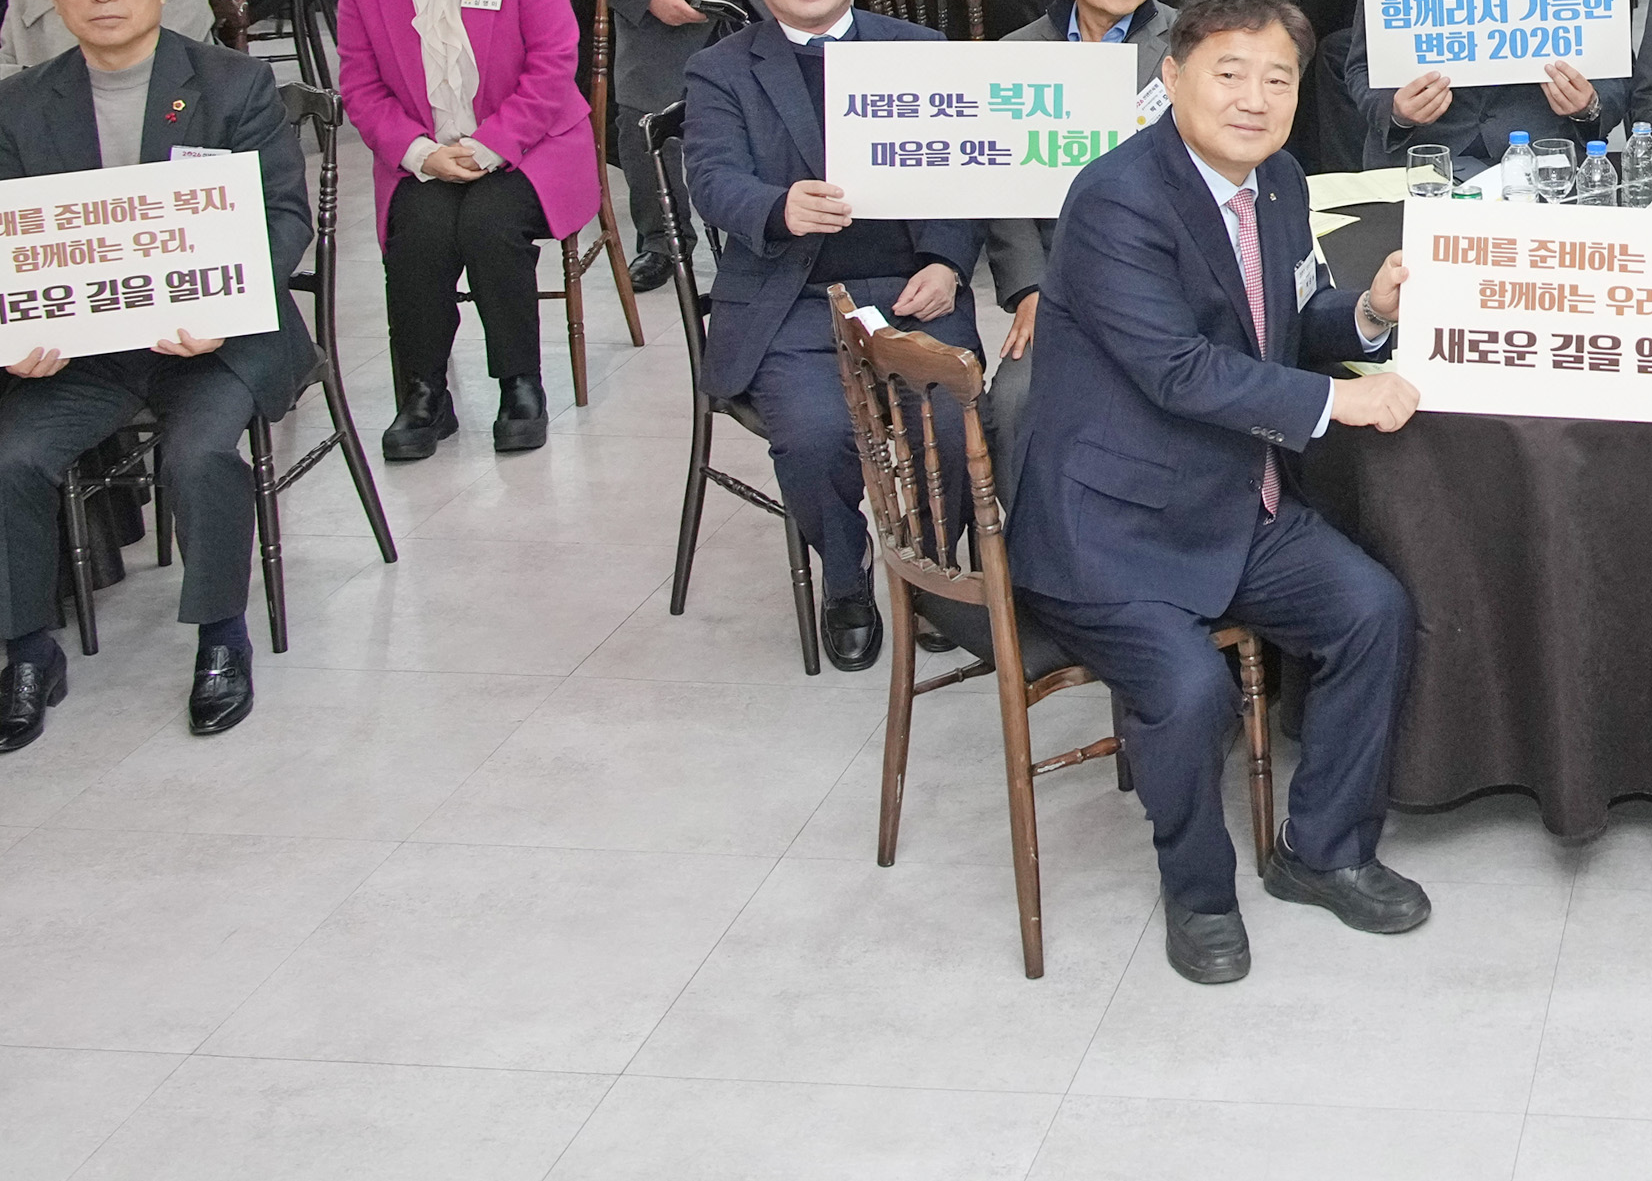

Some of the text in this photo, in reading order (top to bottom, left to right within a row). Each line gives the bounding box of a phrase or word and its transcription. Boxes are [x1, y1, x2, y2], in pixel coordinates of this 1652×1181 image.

[1414, 25, 1583, 64] 변화 2026!
[843, 83, 1072, 120] 사람을 잇는 복지,
[871, 140, 951, 167] 마음을
[960, 140, 1011, 166] 잇는
[54, 186, 236, 230] 준비하는 복지,
[12, 228, 195, 273] 함께하는 우리,
[1432, 235, 1519, 268] 미래를
[1528, 239, 1646, 274] 준비하는
[86, 263, 245, 313] 길을 열다!
[1479, 279, 1596, 314] 함께하는
[1428, 328, 1538, 368] 새로운
[1550, 333, 1622, 372] 길을
